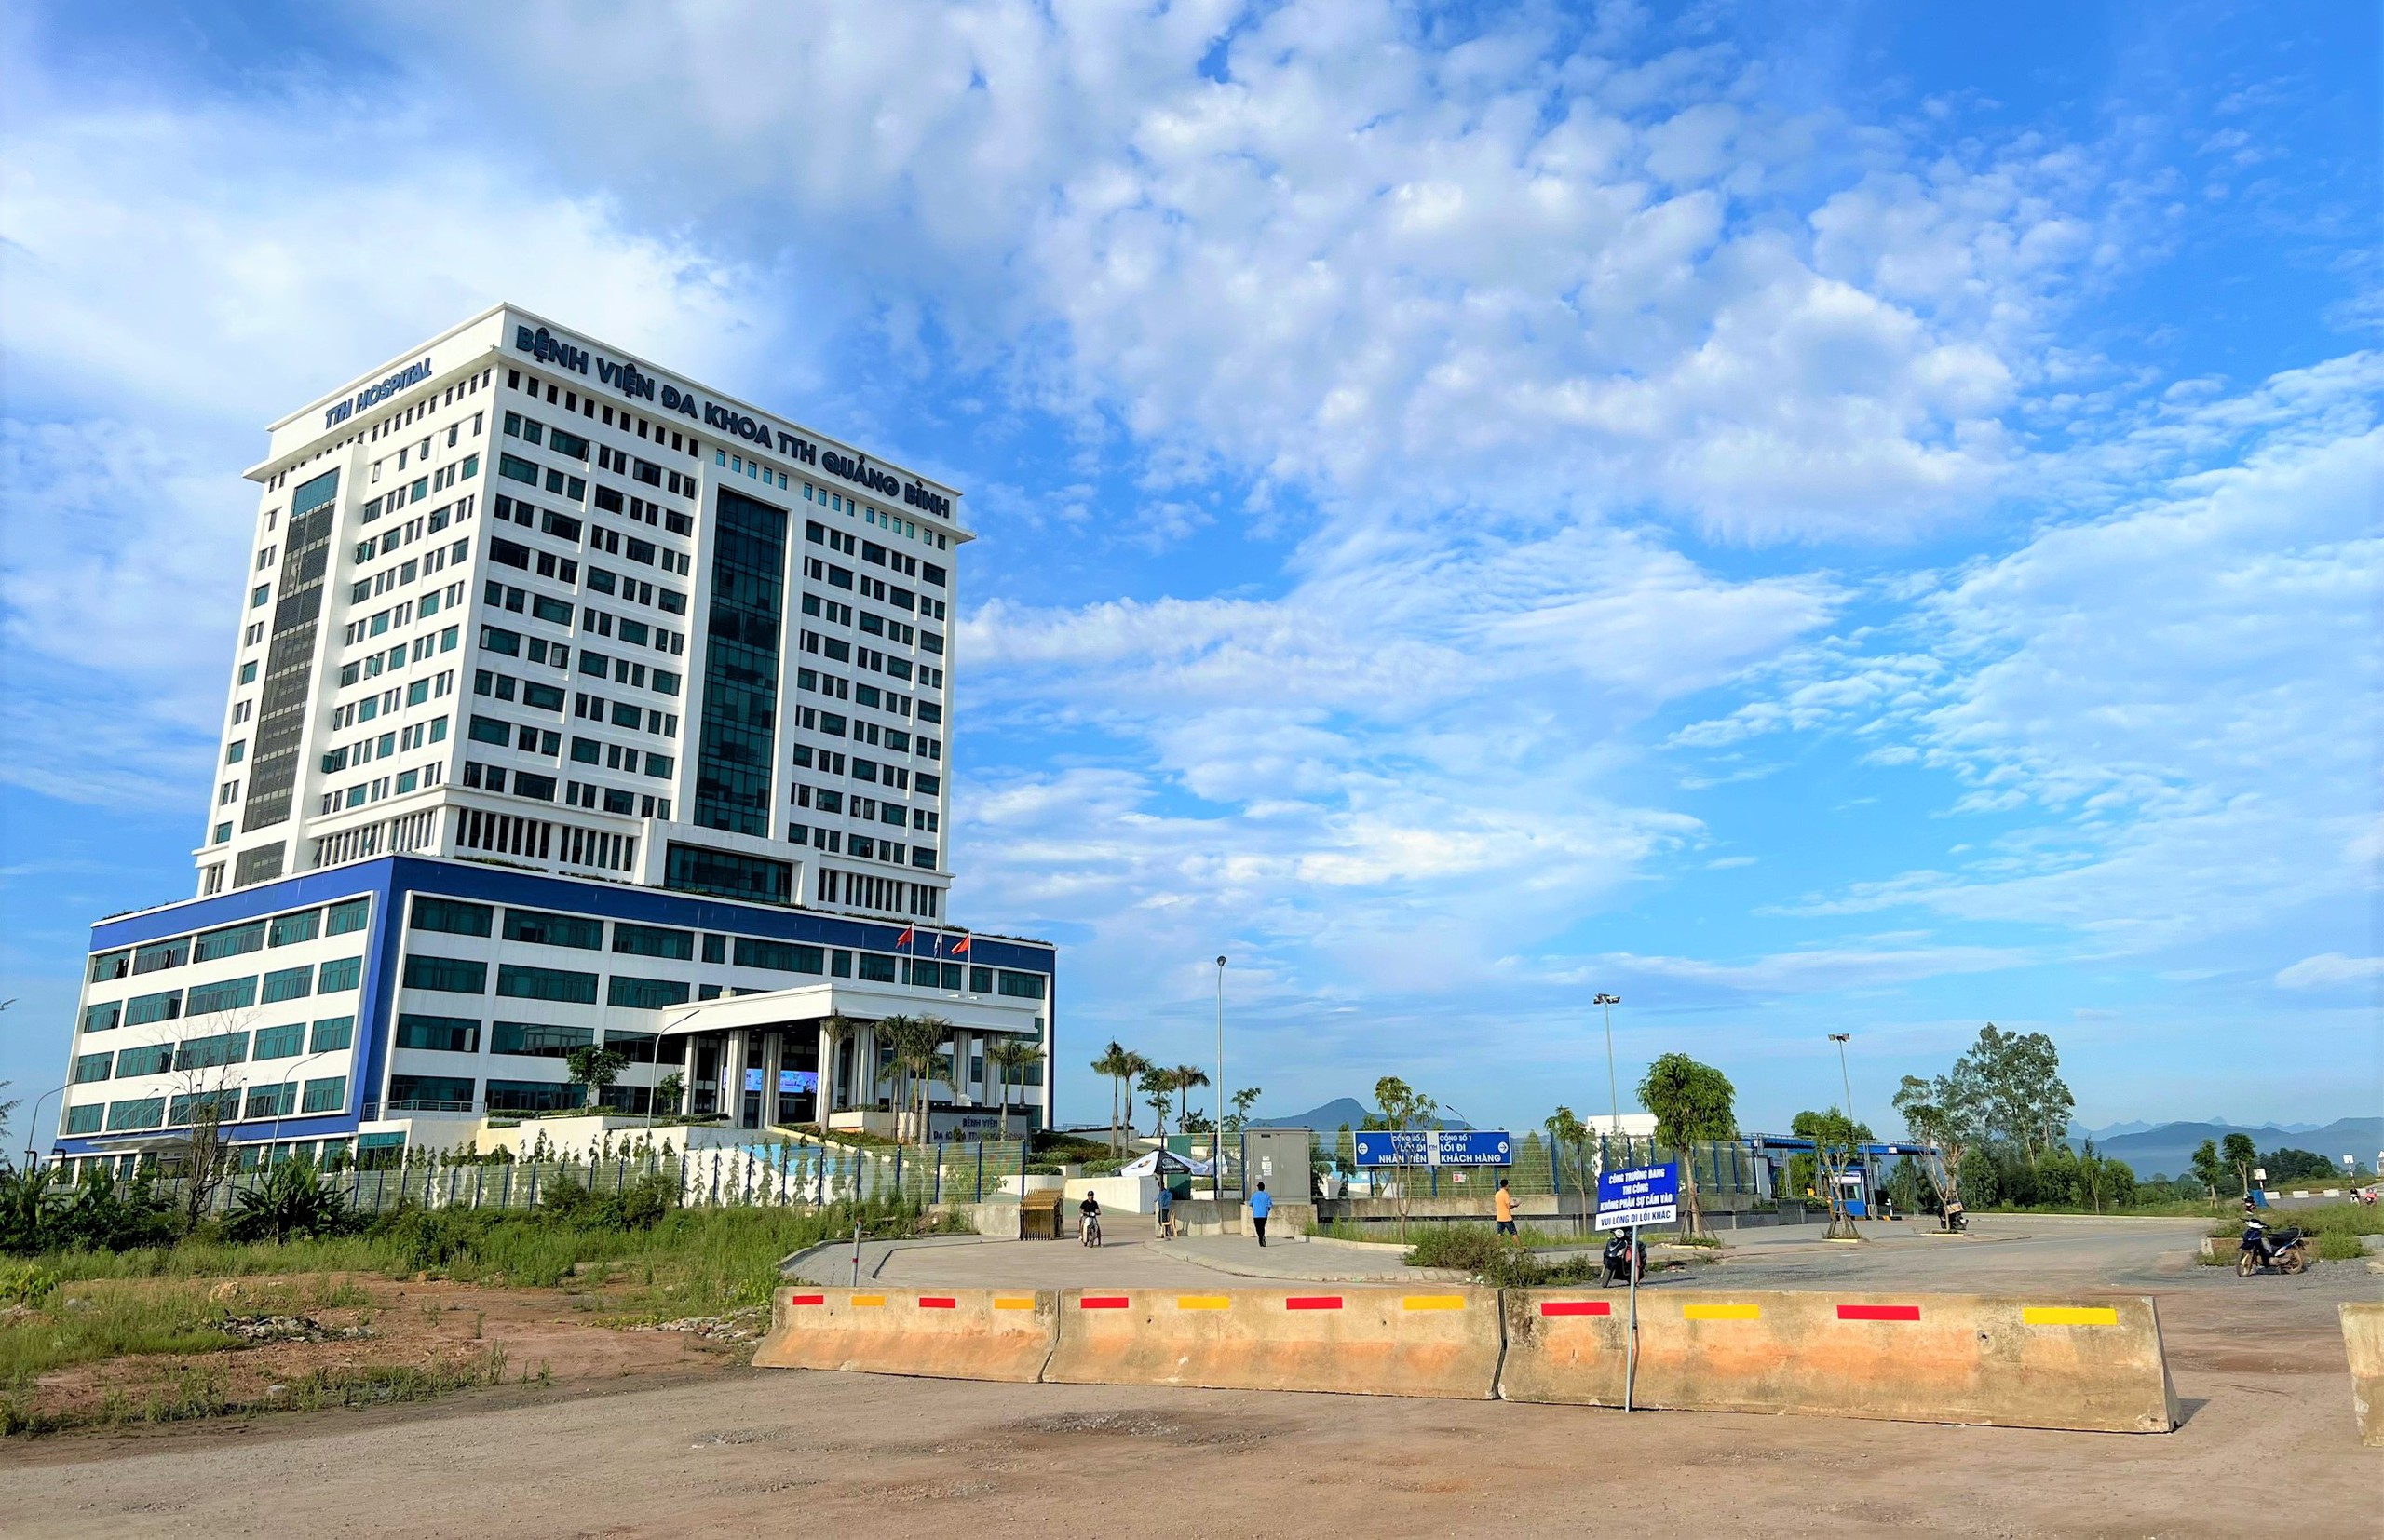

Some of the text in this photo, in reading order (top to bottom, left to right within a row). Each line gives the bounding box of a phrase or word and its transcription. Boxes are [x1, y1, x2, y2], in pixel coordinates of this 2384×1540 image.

[326, 357, 432, 430] TTH HOSPITAL
[516, 325, 950, 519] BỆNH VIỆN ĐA KHOA TTH QUẢNG BÌNH
[1458, 1133, 1468, 1141] SỐ
[1440, 1141, 1467, 1153] LỐI ĐI
[1378, 1153, 1404, 1164] NHÂN
[1441, 1152, 1502, 1163] KHÁCH HÀNG
[1601, 1217, 1611, 1227] VUI
[1631, 1213, 1638, 1223] ĐI
